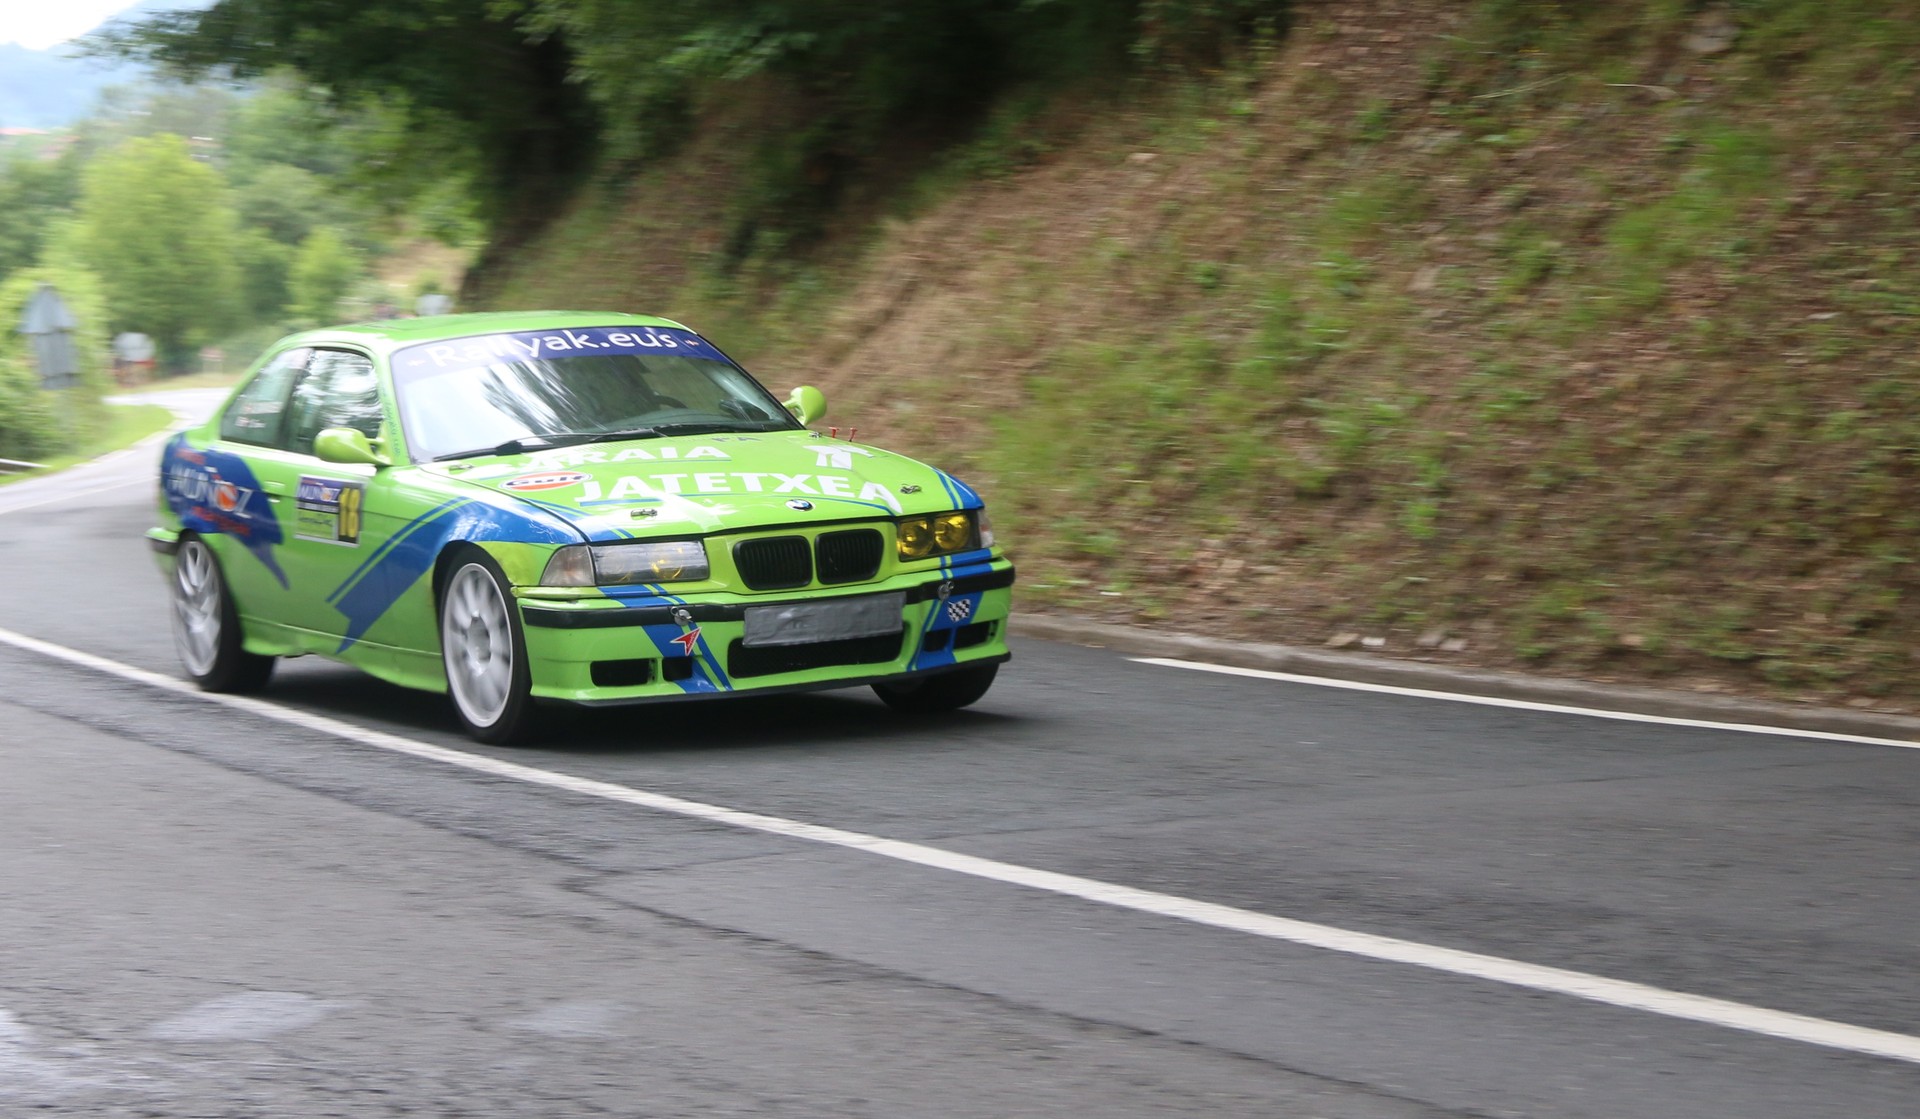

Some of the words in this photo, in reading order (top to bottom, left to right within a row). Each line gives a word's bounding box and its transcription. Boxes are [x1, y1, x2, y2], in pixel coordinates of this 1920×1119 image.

[426, 330, 677, 367] Rallyak.eus
[474, 445, 729, 474] ARAIA
[505, 475, 585, 487] Gulf
[574, 472, 904, 513] JATETXEA
[339, 487, 361, 538] 18
